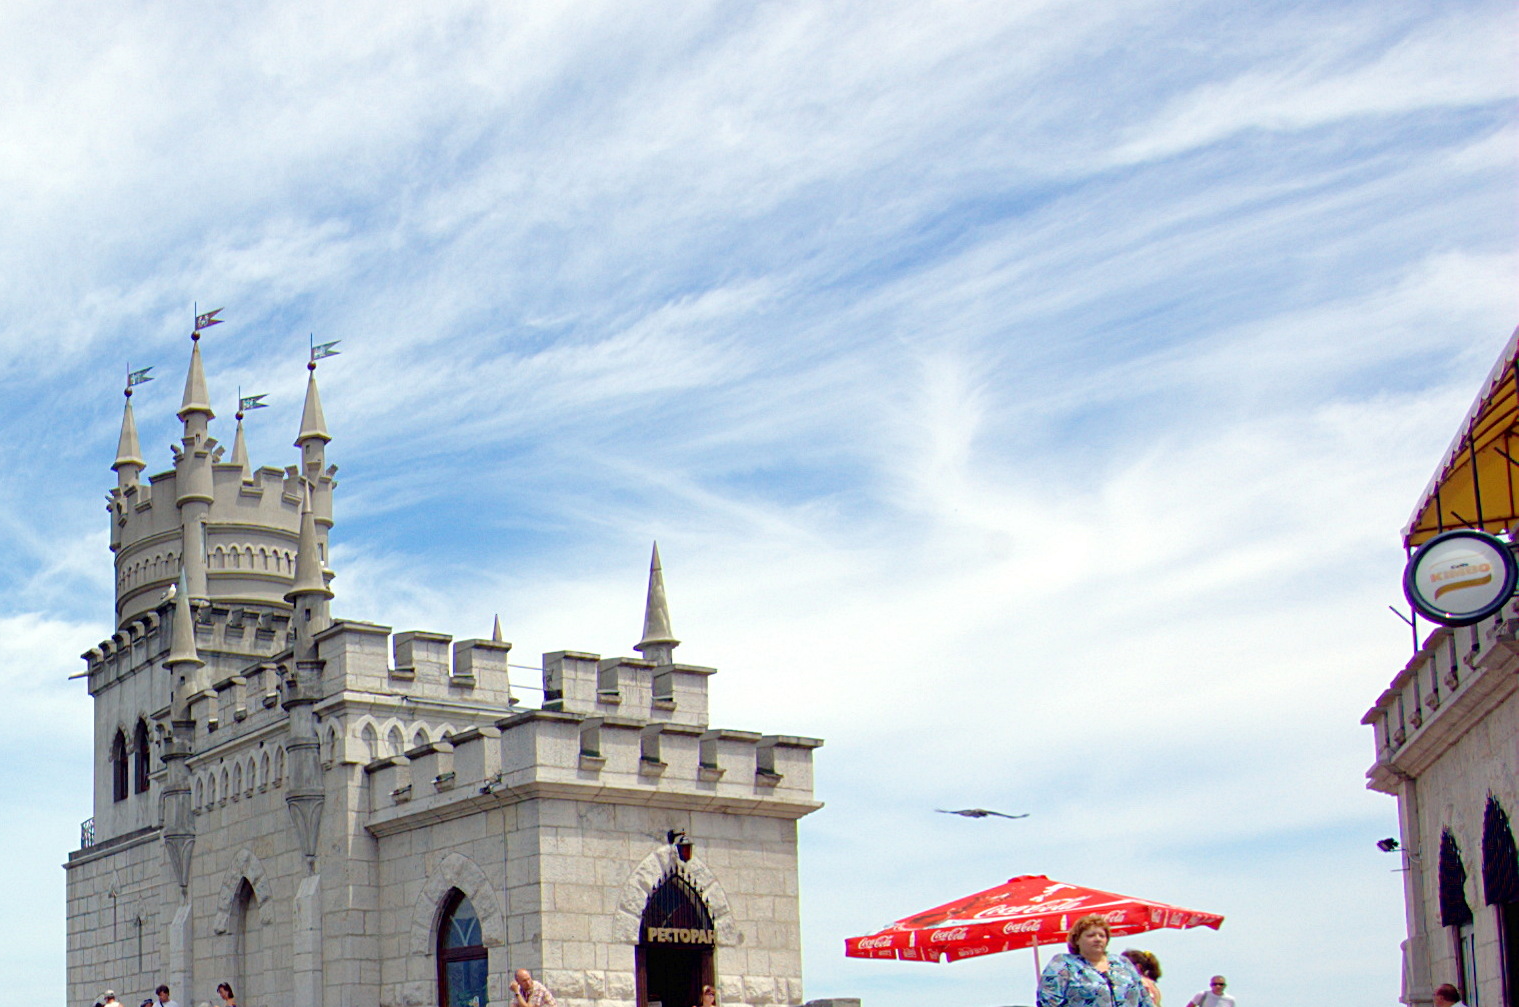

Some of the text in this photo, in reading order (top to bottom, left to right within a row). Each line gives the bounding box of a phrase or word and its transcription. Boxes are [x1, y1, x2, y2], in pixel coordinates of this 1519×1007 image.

[974, 895, 1093, 918] Coca-Cola
[1003, 918, 1043, 934] Coca-Cola
[858, 935, 894, 949] Coca-Cola
[931, 927, 969, 942] Coca-Cola
